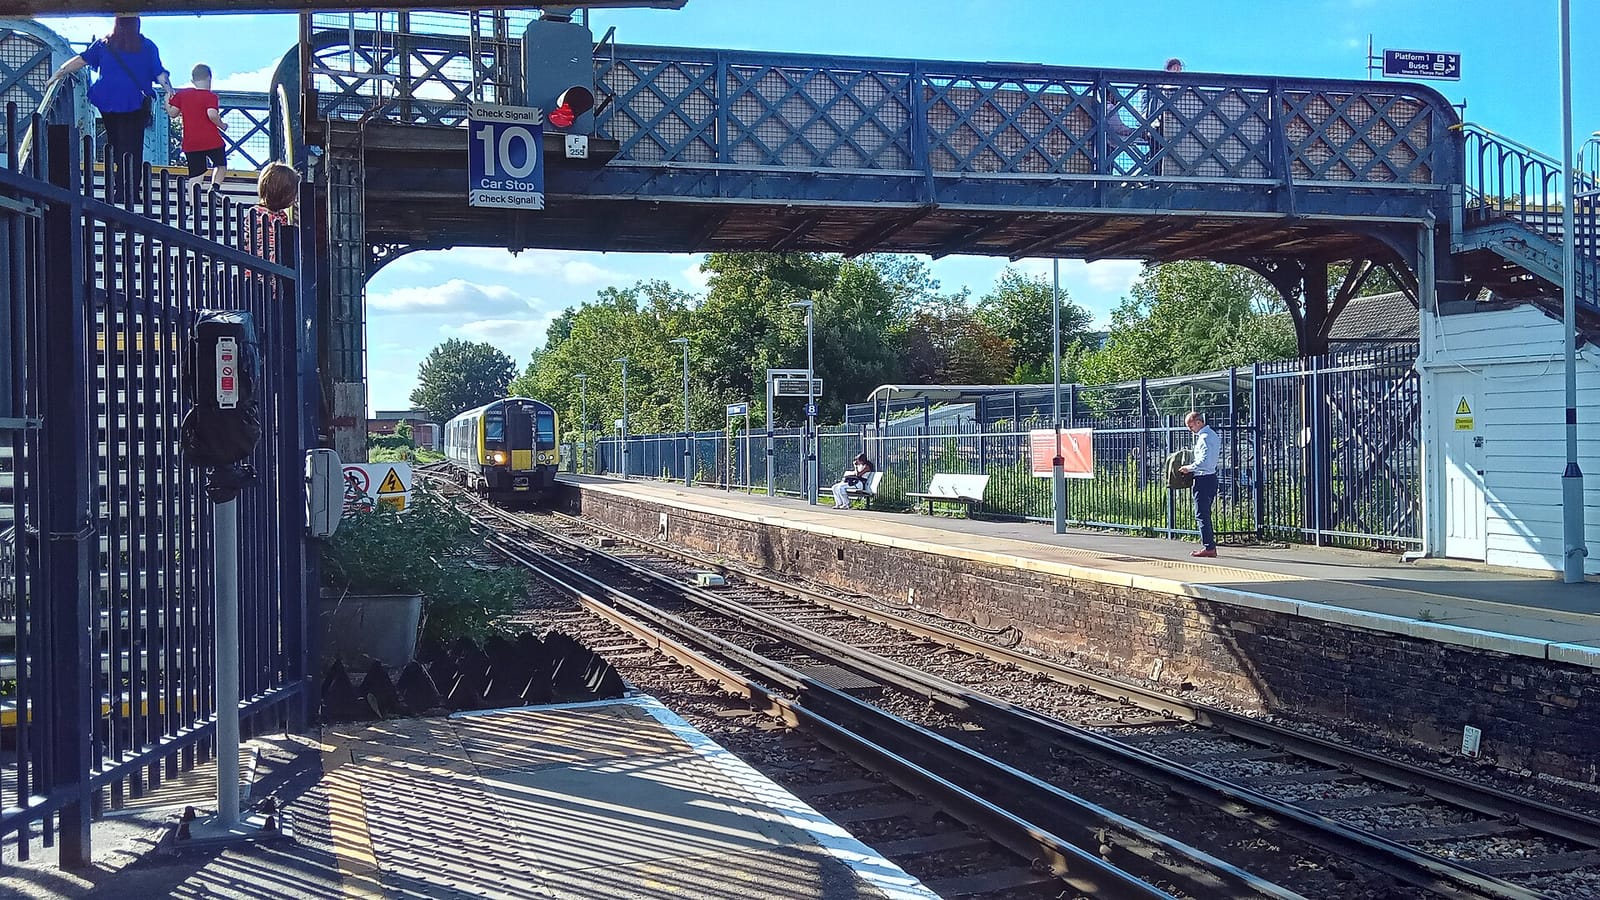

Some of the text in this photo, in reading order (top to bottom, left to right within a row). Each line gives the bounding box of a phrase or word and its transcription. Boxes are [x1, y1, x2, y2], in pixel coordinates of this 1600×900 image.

[1394, 52, 1425, 61] Platform
[1408, 61, 1429, 70] Buses
[476, 108, 504, 119] Check
[476, 124, 537, 179] 10
[480, 178, 535, 192] Car Stop
[479, 194, 506, 204] Check
[808, 404, 816, 413] 8
